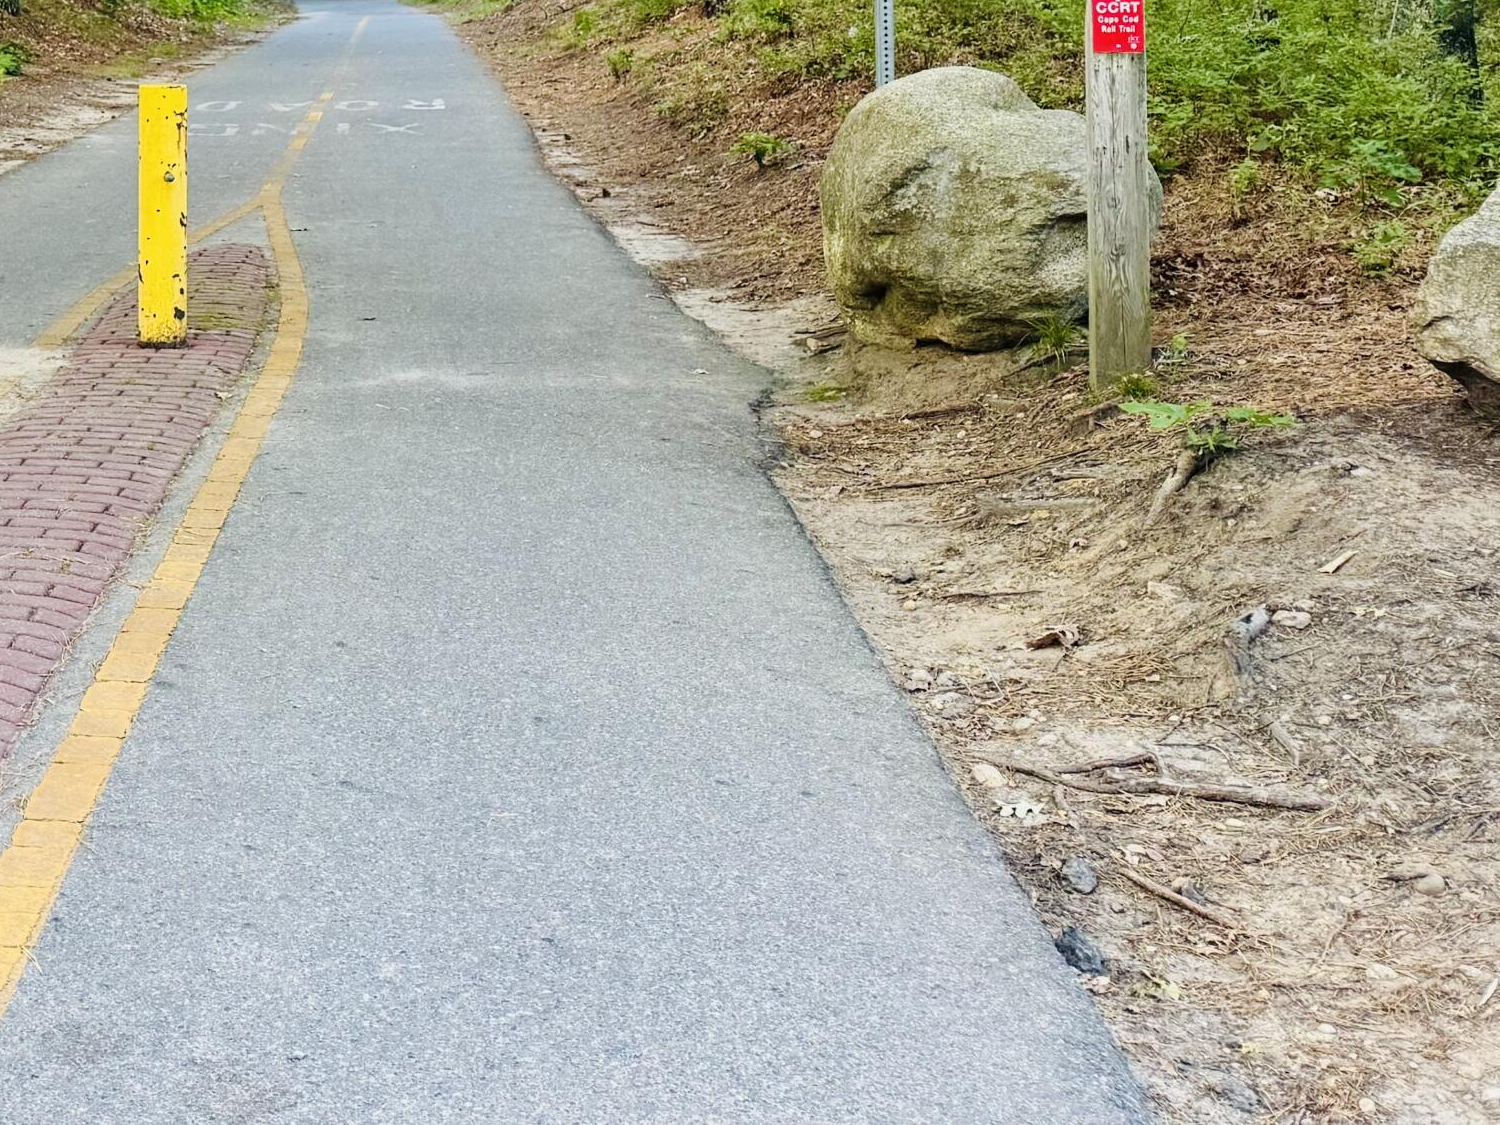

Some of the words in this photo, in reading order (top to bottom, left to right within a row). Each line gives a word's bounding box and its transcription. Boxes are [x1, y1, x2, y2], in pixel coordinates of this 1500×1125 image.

[1096, 1, 1140, 14] CCRT
[1097, 15, 1119, 25] Cape
[1122, 15, 1139, 23] Cod
[1101, 25, 1116, 33] Rail
[1119, 25, 1136, 33] Trail
[196, 98, 446, 113] ROAD
